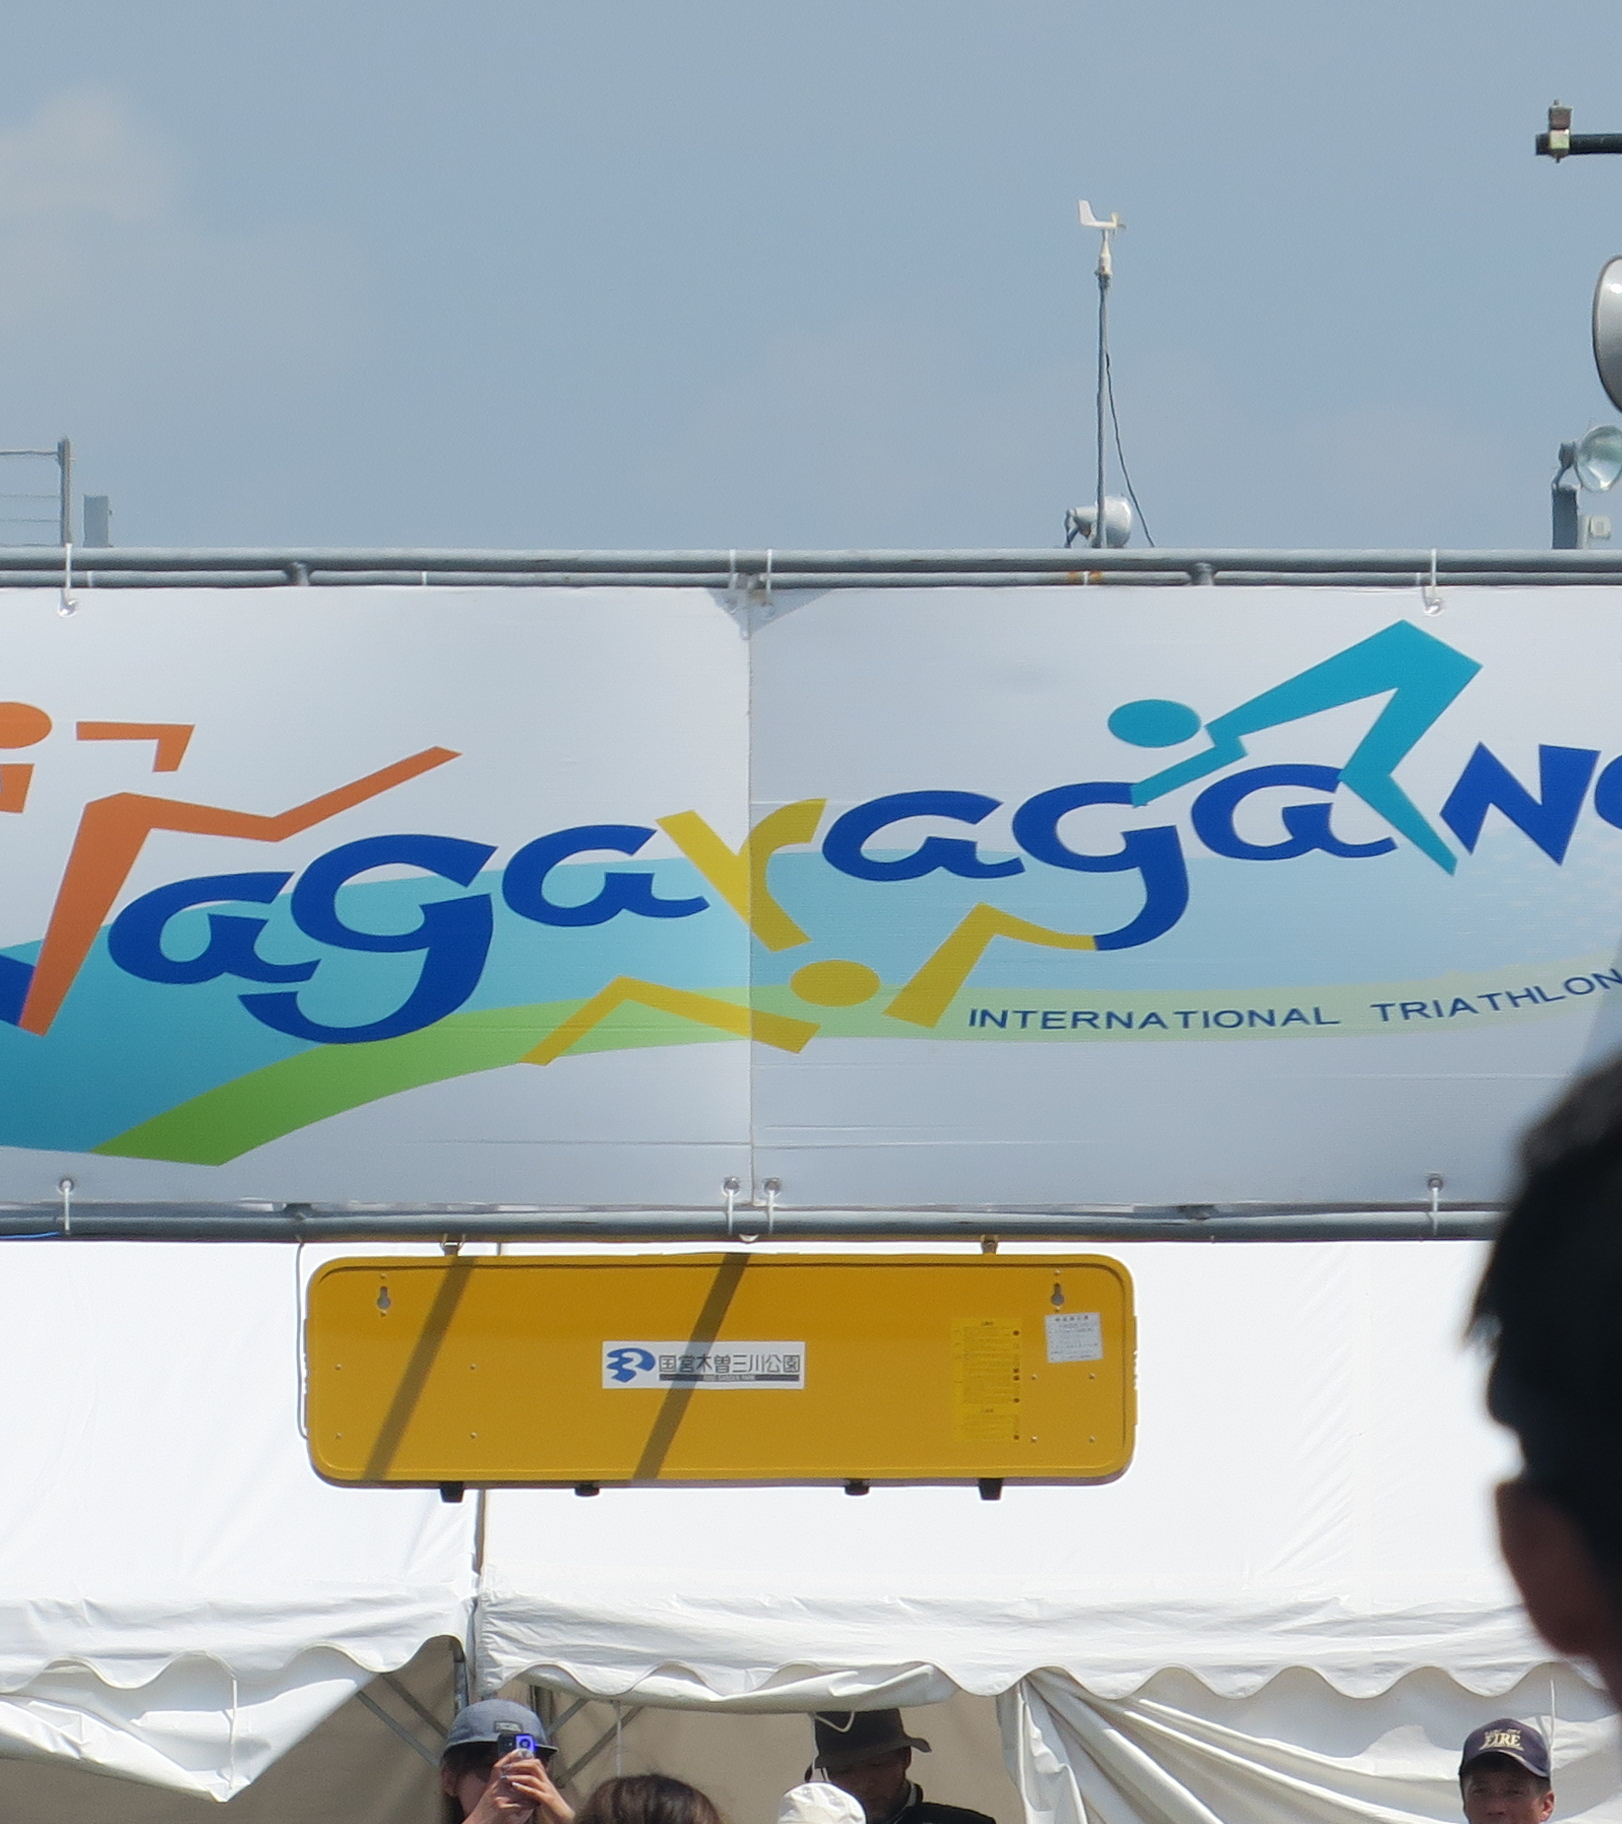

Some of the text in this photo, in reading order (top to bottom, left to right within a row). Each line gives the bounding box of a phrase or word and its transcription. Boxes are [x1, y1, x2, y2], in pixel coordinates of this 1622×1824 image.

[968, 1008, 1340, 1030] INTERNATIONAL
[659, 1354, 801, 1373] 国営木曽三川公園
